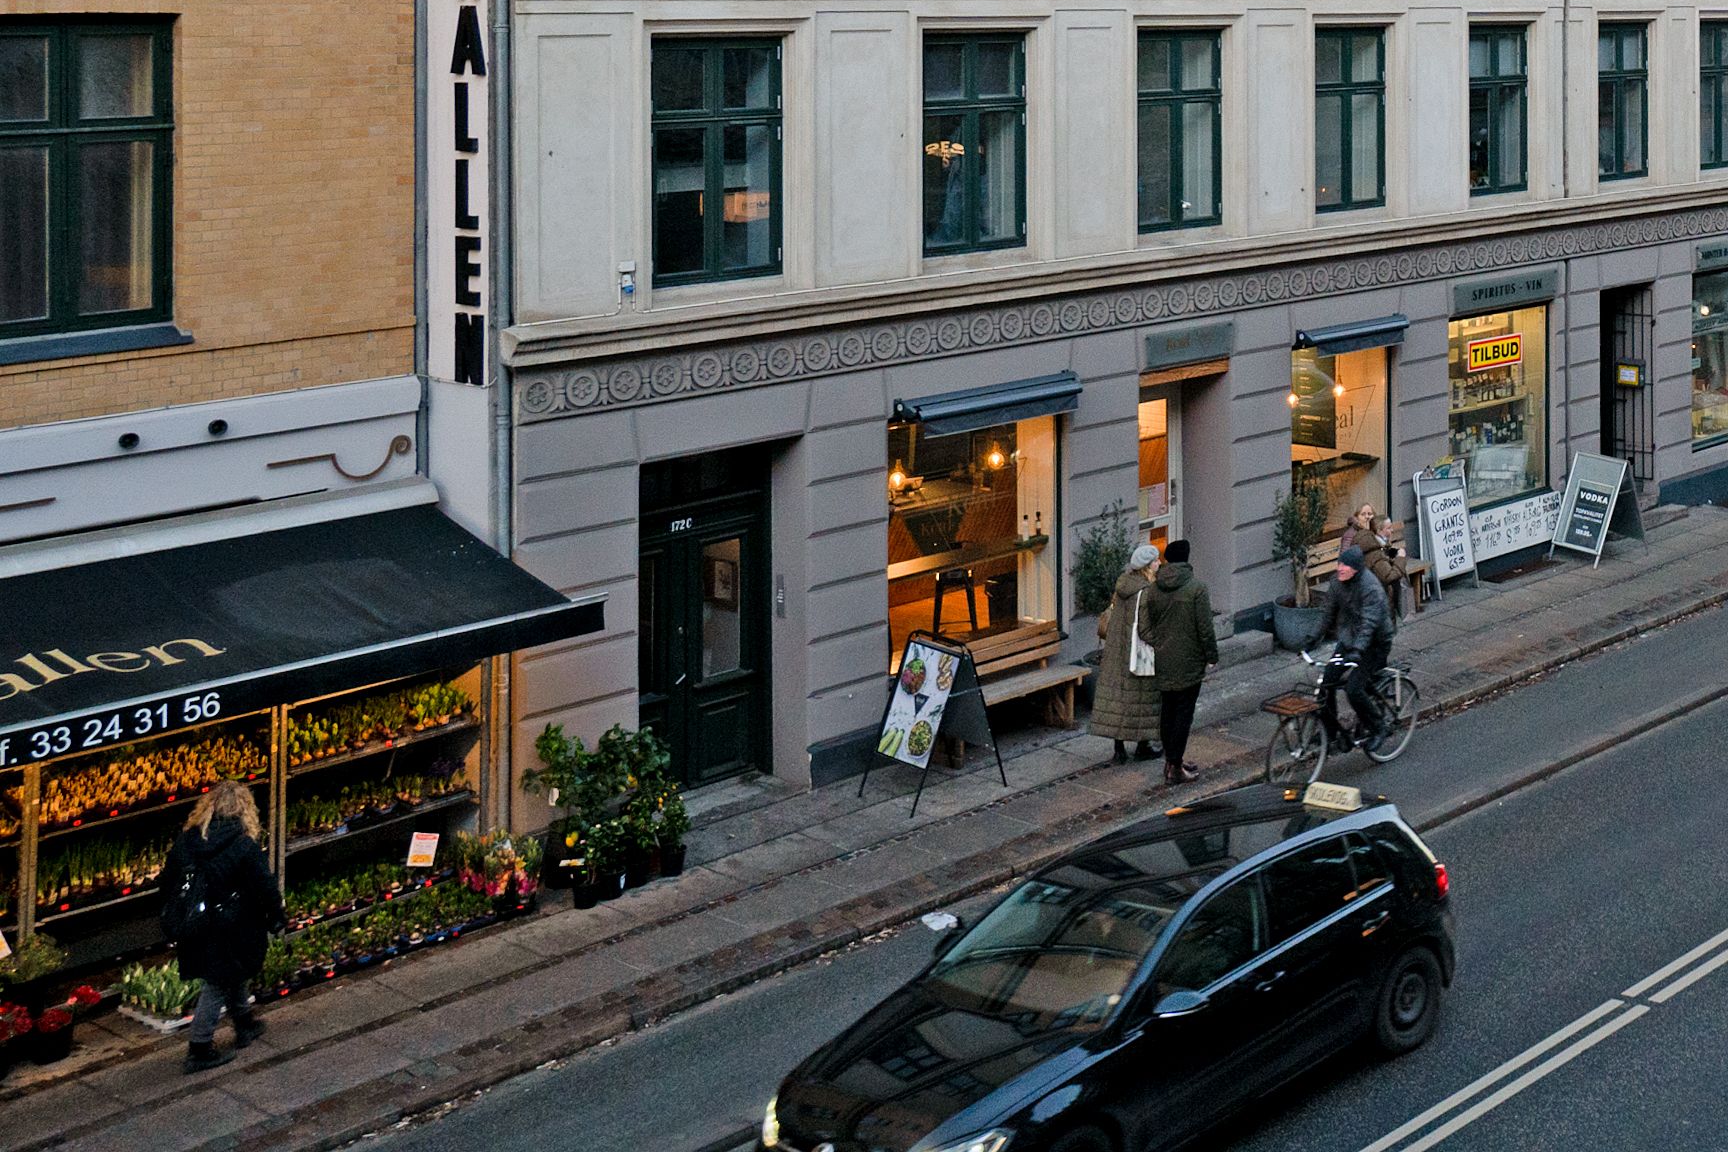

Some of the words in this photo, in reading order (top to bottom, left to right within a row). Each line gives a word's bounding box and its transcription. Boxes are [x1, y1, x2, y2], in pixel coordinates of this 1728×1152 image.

[1472, 282, 1516, 302] SPIRITUS
[1526, 278, 1543, 291] VIN
[1472, 341, 1519, 363] TILBUD
[1580, 491, 1608, 505] VODKA
[31, 726, 72, 759] 33
[82, 714, 124, 749] 24
[134, 703, 169, 736] 31
[183, 692, 221, 724] 56
